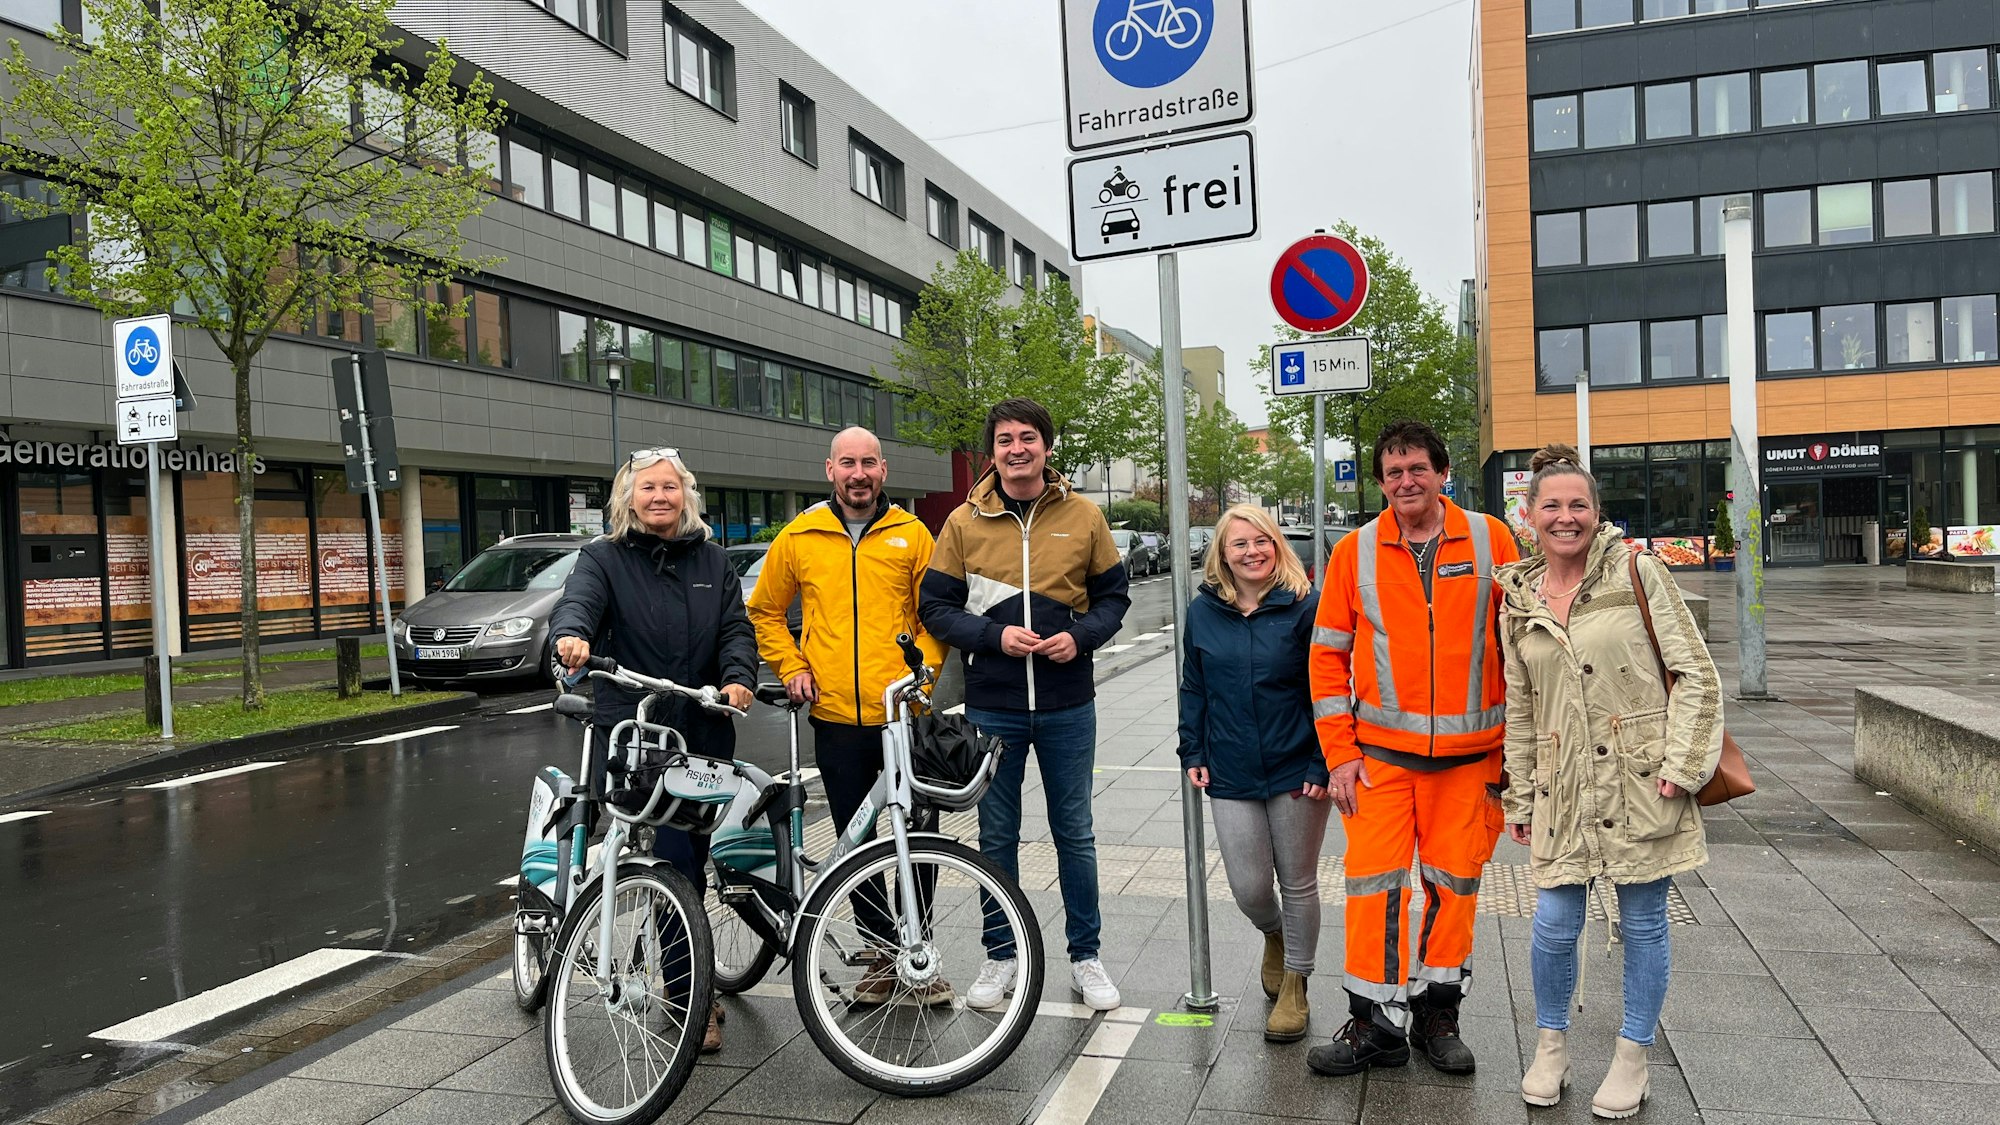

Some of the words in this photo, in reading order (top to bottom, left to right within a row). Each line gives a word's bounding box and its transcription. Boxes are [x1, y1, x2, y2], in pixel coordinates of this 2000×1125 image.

[1078, 88, 1239, 134] Fahrradstraße
[1163, 164, 1241, 216] frei
[1312, 359, 1327, 373] 15
[1329, 357, 1360, 372] Min.
[121, 378, 169, 392] Fahrradstraße
[147, 409, 171, 428] frei
[0, 430, 267, 475] Generationenhas
[1766, 448, 1807, 461] UMUT
[1829, 443, 1880, 458] DÖNER
[1339, 462, 1351, 480] P
[129, 564, 140, 572] IST
[271, 560, 280, 568] IST
[281, 560, 299, 568] MEHR
[420, 649, 428, 658] SU
[431, 649, 441, 658] XH
[441, 649, 459, 658] 1984
[697, 781, 721, 790] BIKE
